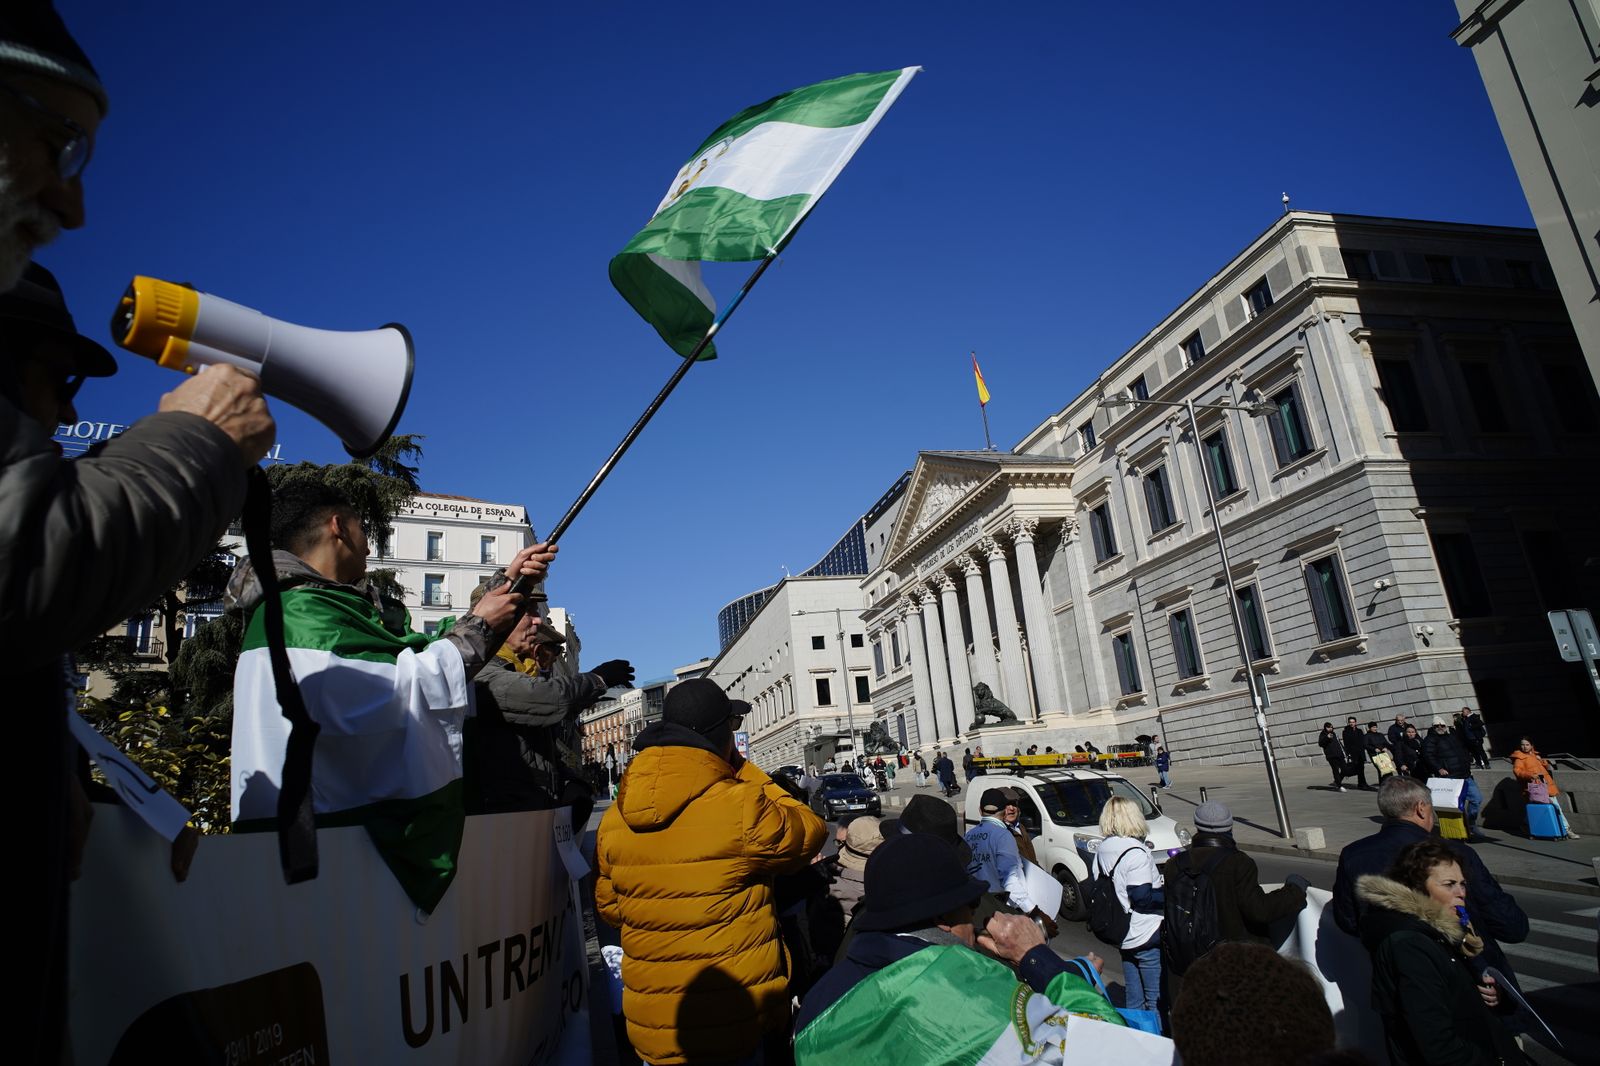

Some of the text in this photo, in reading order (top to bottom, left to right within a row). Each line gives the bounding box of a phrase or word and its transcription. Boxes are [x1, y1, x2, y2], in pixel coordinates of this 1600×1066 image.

[54, 420, 131, 440] HOTE
[425, 502, 469, 513] COLEGIAL
[470, 506, 482, 515] DE
[485, 508, 516, 518] ESPAÑA
[966, 832, 988, 841] CAMPO
[400, 953, 468, 1049] UN
[477, 915, 558, 1010] TREN
